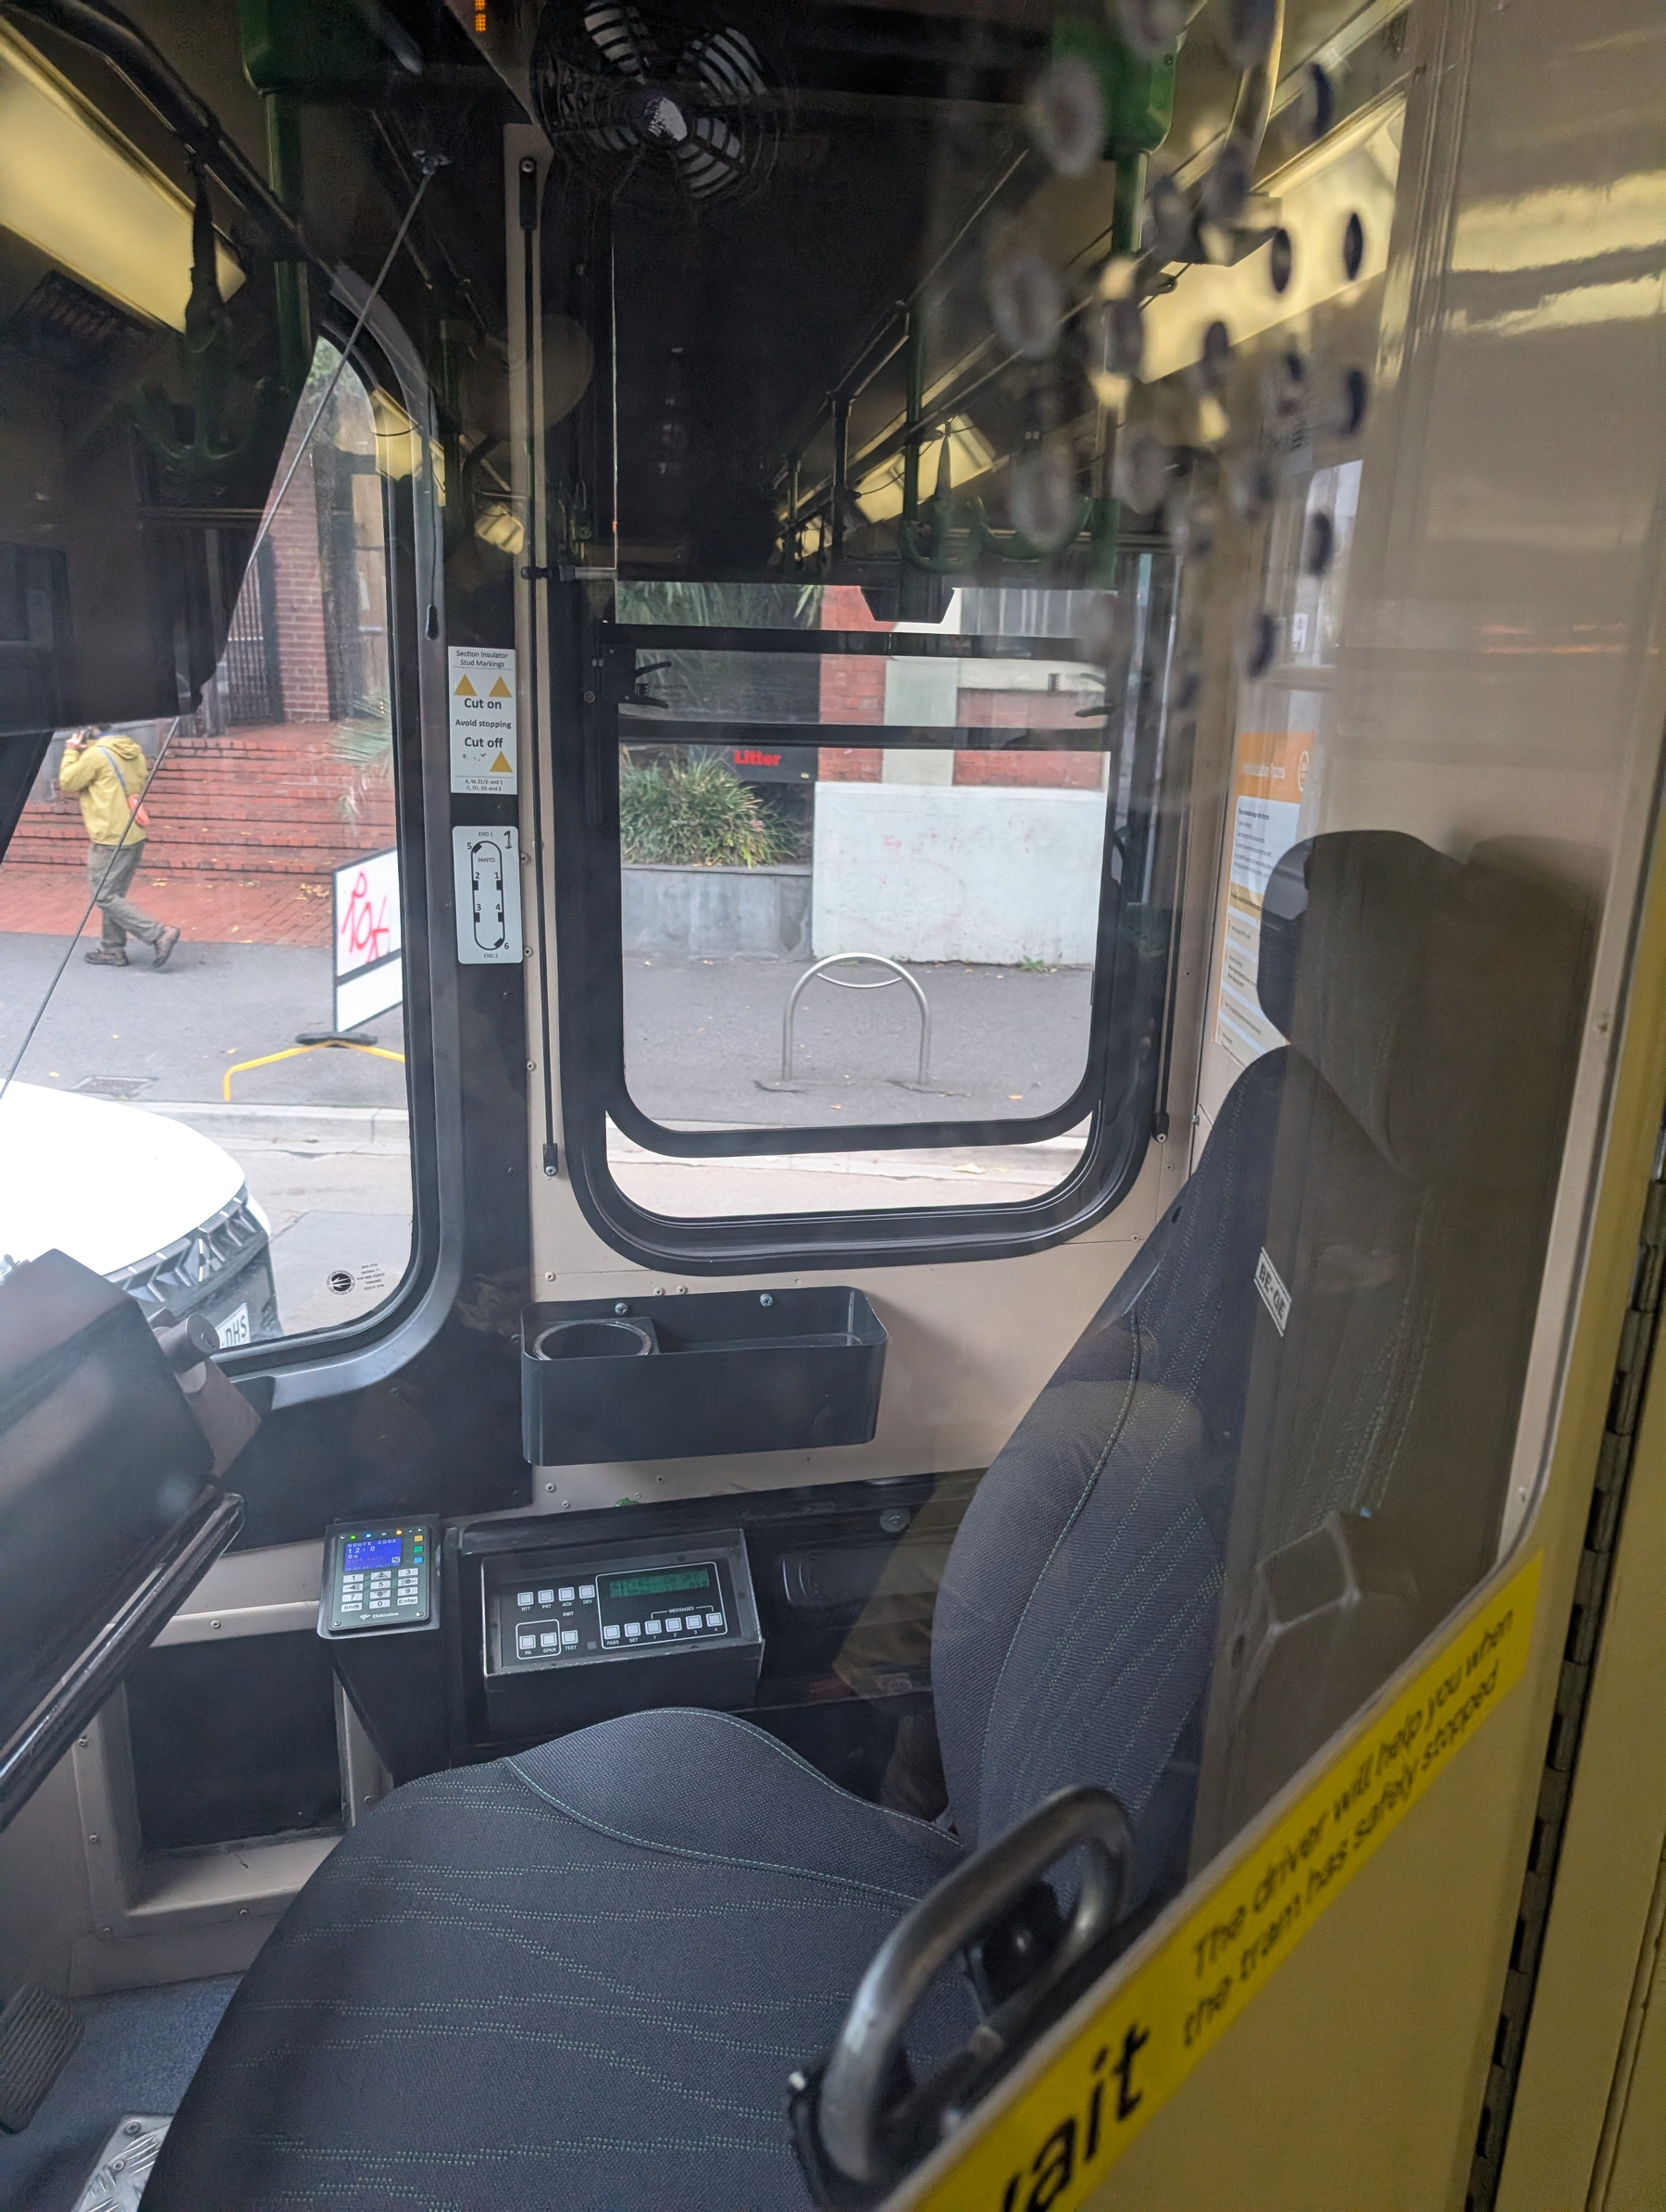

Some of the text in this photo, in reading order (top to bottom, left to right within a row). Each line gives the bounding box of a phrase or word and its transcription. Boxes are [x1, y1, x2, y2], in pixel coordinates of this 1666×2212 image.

[456, 650, 509, 659] Section Insulator
[476, 660, 505, 668] Markings
[464, 698, 502, 710] Cut on
[455, 718, 512, 729] Avoid stopping
[464, 737, 504, 748] Cut off
[734, 749, 781, 766] Litter
[1191, 1609, 1513, 1979] The driver will help you when
[1184, 1659, 1501, 2048] the tram has safely stopped
[999, 2020, 1151, 2212] ait
